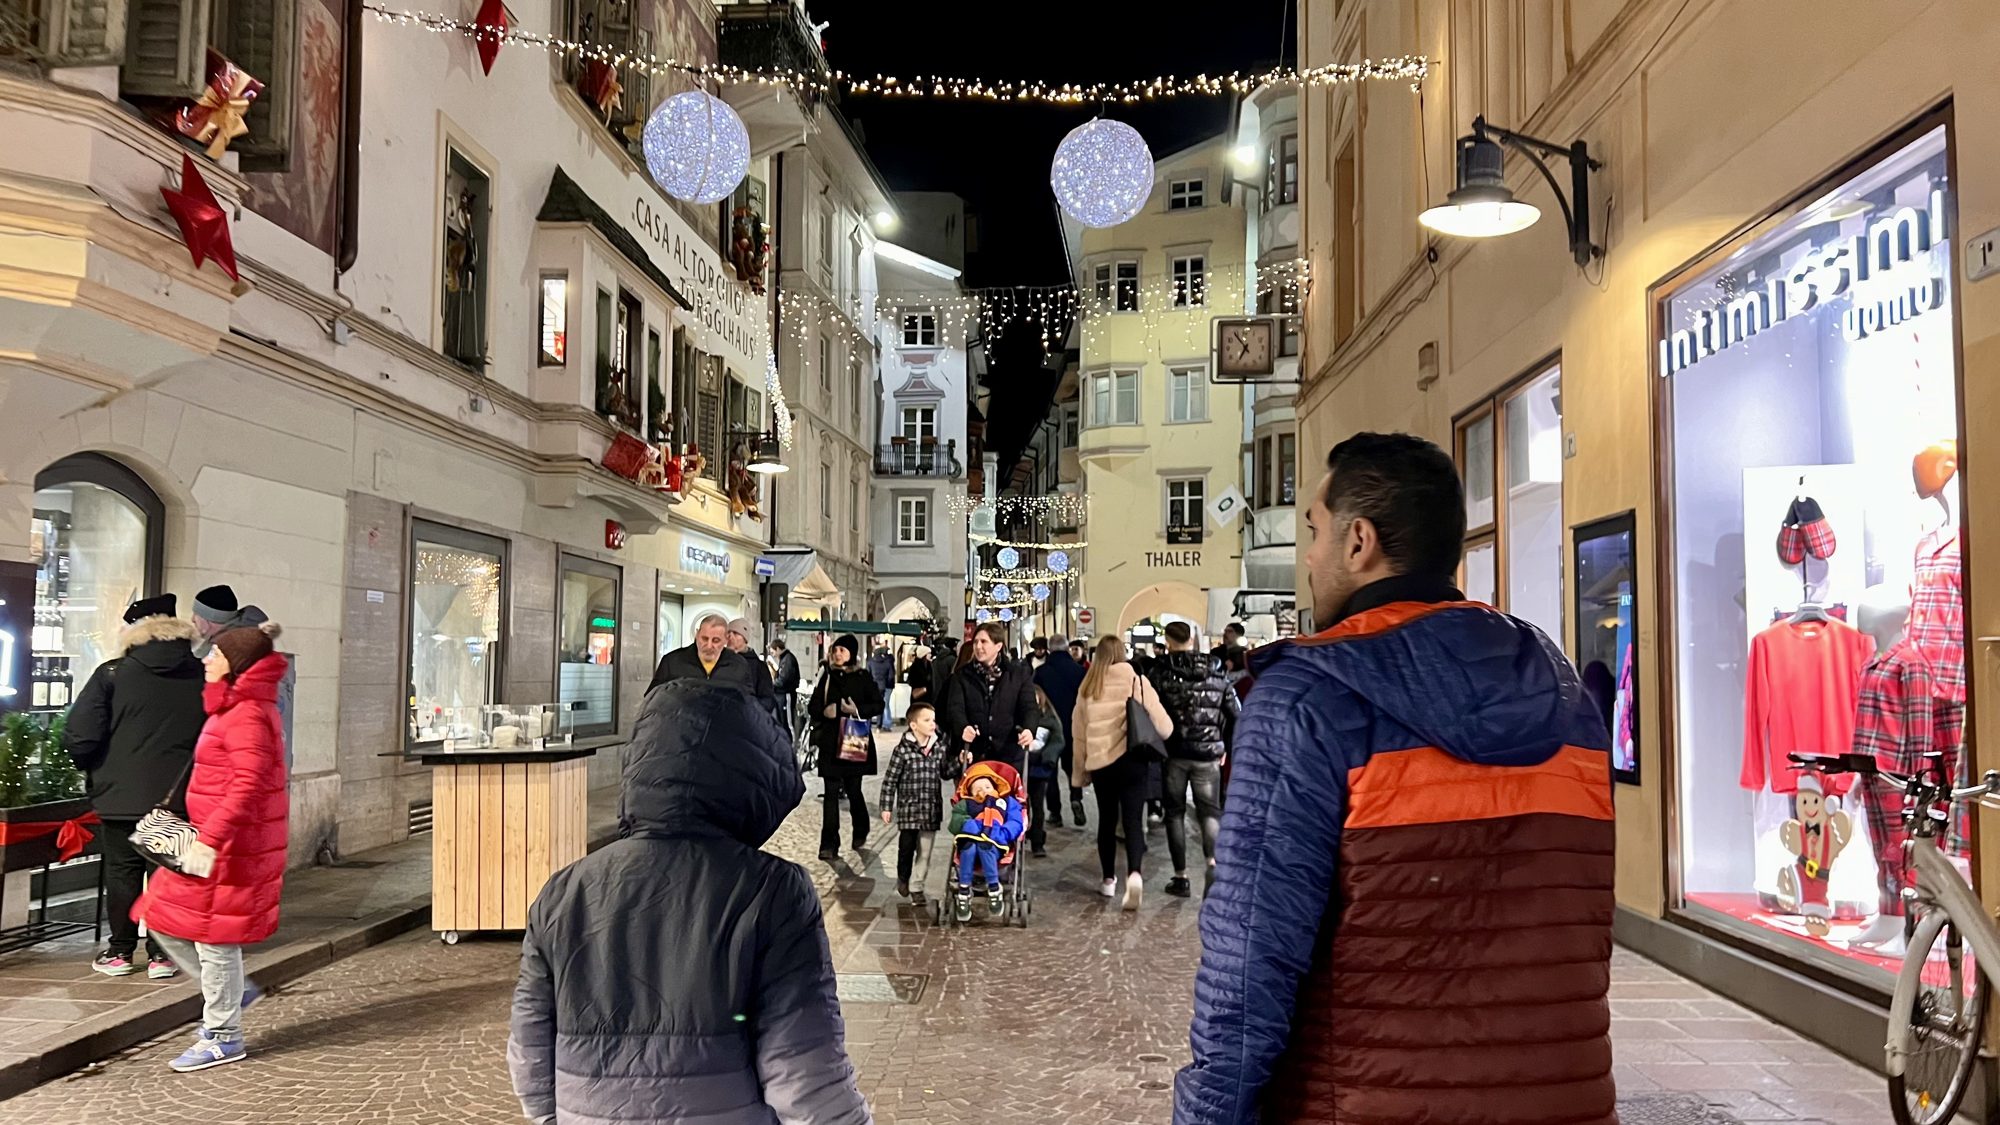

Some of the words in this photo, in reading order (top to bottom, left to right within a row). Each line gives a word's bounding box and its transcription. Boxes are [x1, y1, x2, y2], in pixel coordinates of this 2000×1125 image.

[673, 234, 689, 272] AL
[1659, 188, 1947, 378] intimissimi
[1842, 275, 1939, 343] uomo
[1145, 551, 1201, 567] THALER
